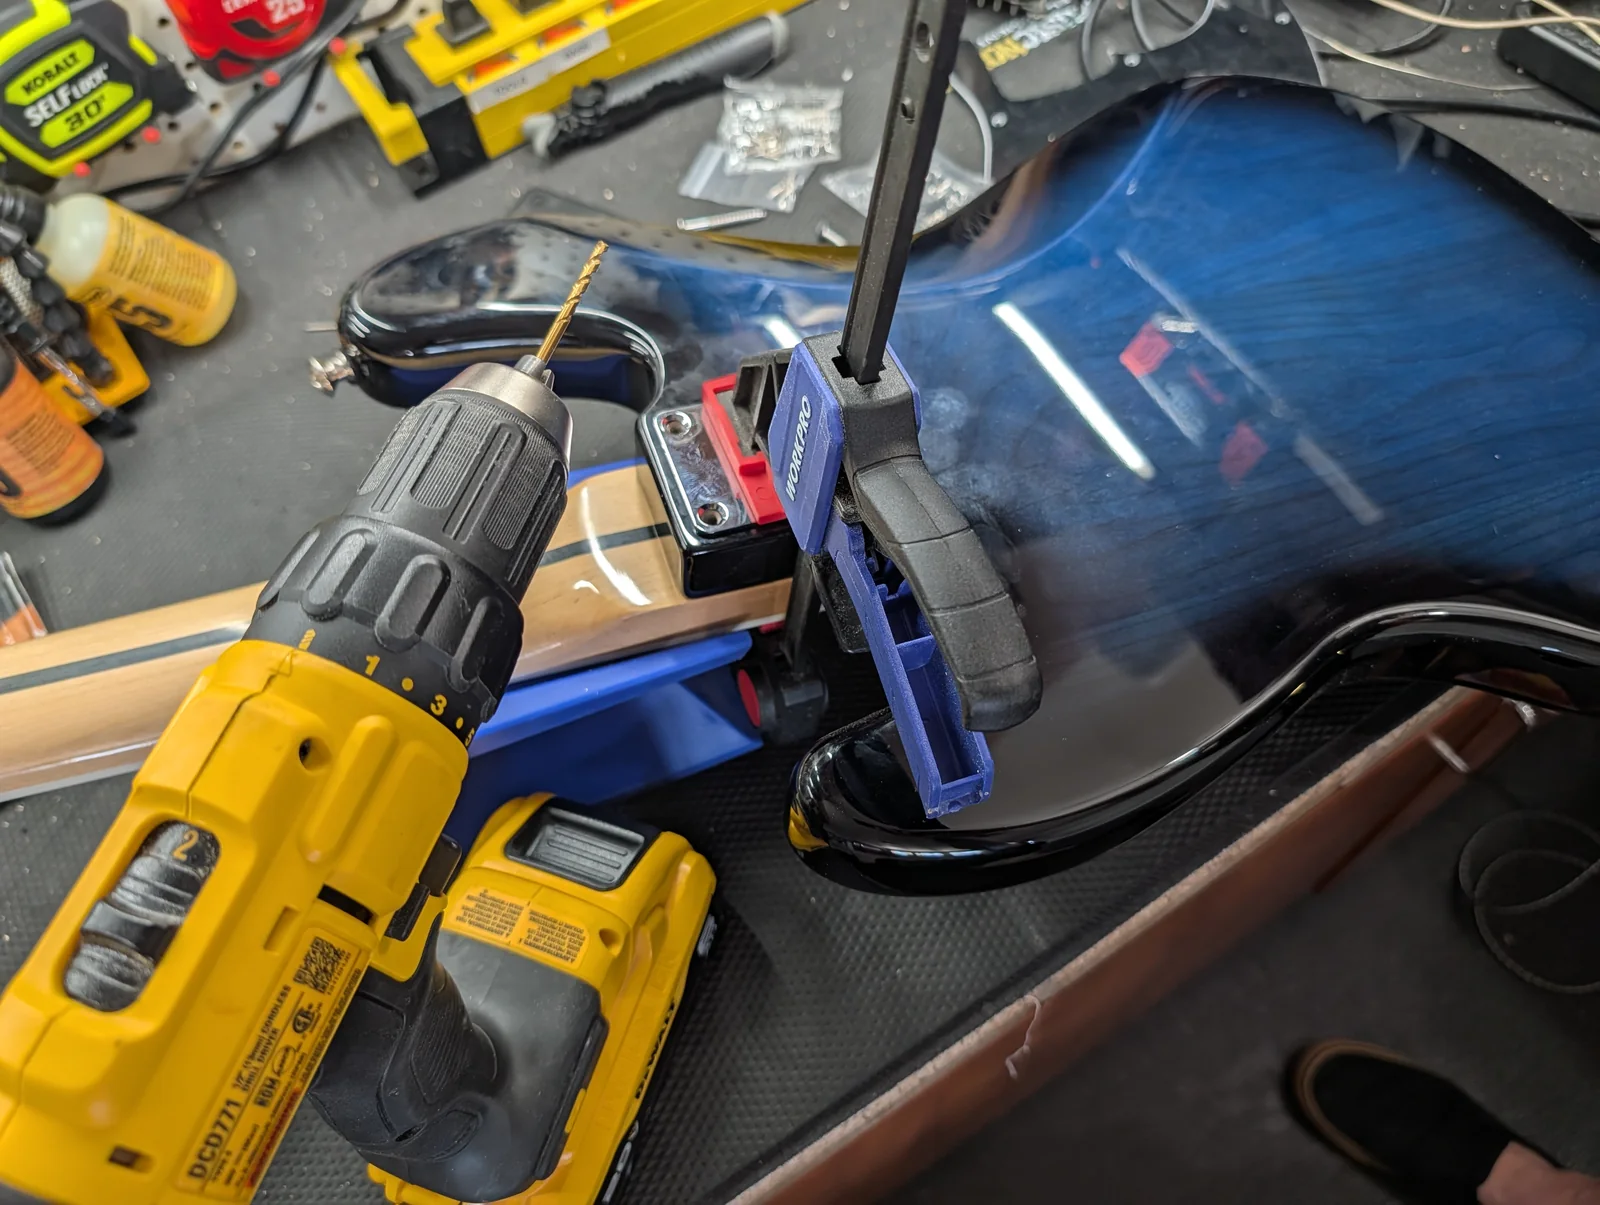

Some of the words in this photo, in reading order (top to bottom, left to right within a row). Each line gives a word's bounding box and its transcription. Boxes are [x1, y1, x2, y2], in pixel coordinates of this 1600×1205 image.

[22, 52, 78, 96] KOBALT
[785, 394, 812, 502] WORKPRO
[364, 655, 381, 677] 1
[430, 694, 448, 716] 3
[172, 829, 199, 861] 2
[187, 1097, 242, 1179] DCD771
